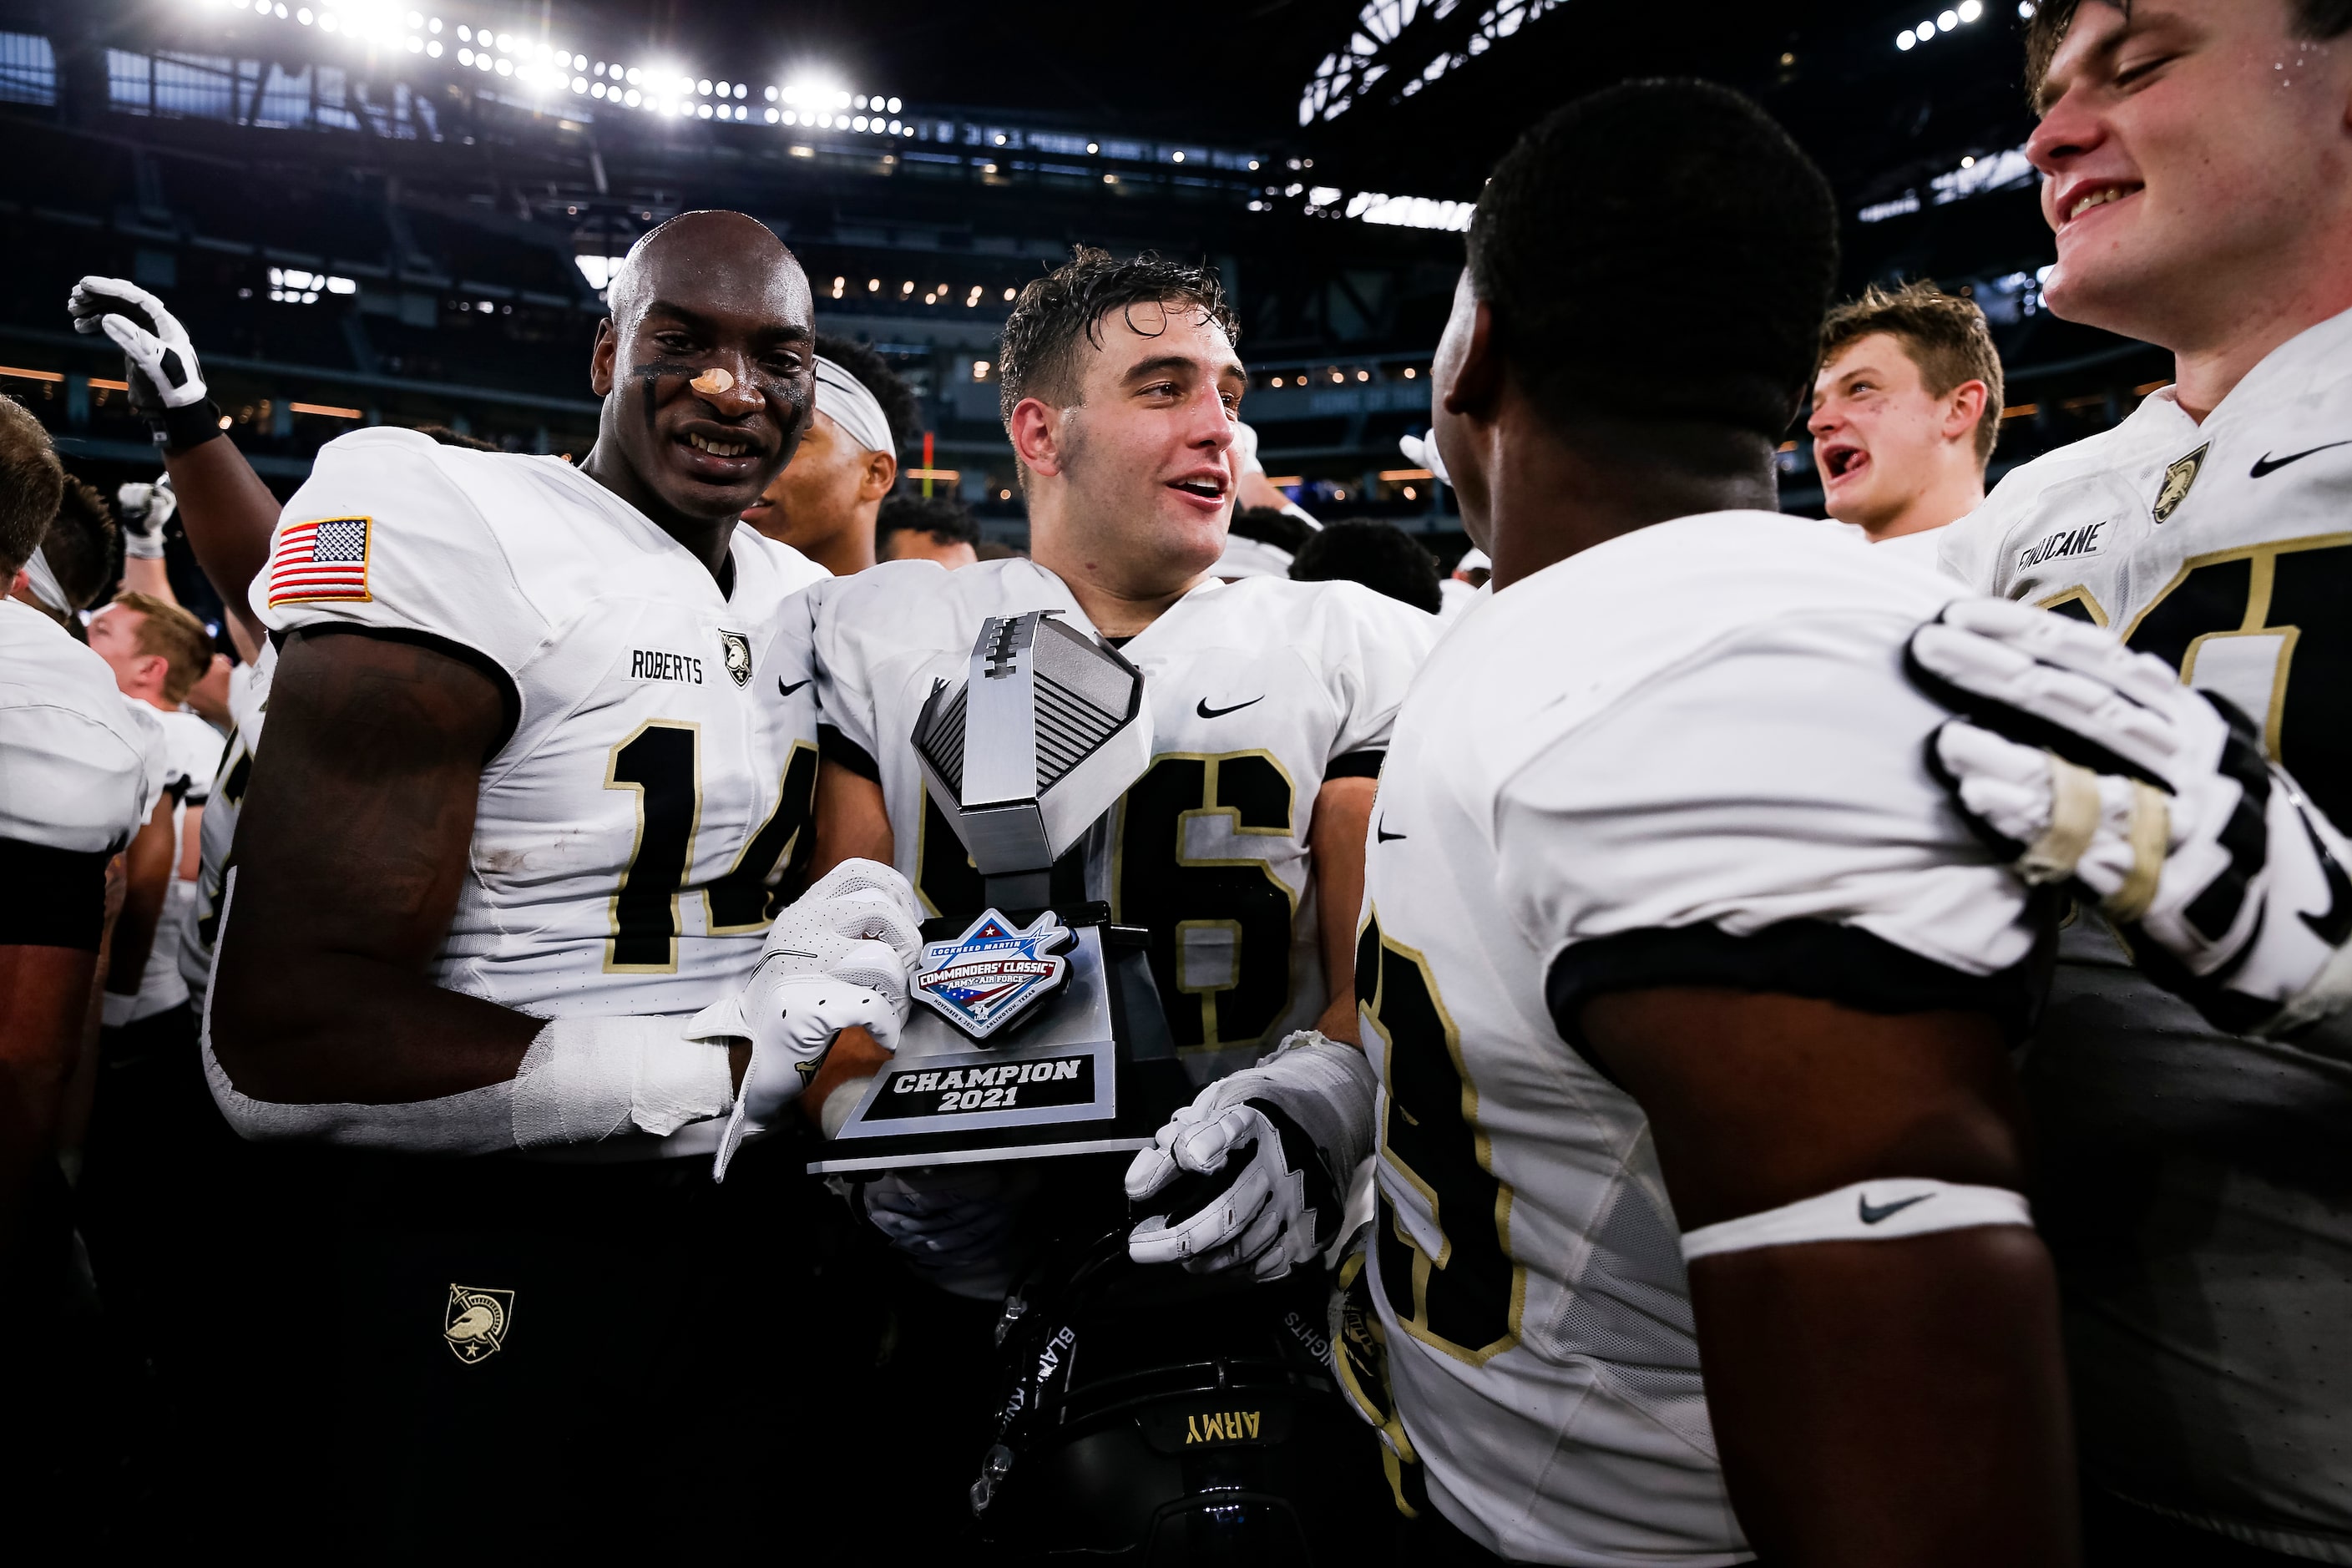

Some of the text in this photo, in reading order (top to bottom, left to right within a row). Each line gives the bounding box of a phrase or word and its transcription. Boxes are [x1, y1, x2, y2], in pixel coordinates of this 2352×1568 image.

[2016, 521, 2107, 574] FINUCANE
[631, 650, 702, 685] ROBERTS
[602, 717, 819, 974] 14
[933, 945, 981, 956] LOCKHEED
[984, 941, 1021, 951] MARTIN
[920, 964, 1001, 986] COMMANDERS'
[947, 975, 1024, 989] ARMY AIR FORCE
[1019, 989, 1035, 1004] TEXAS
[934, 999, 958, 1019] NOVEMBER
[964, 1020, 975, 1030] 2021
[893, 1060, 1081, 1094] CHAMPION
[937, 1086, 1018, 1111] 2021
[1186, 1411, 1260, 1444] ARMY
